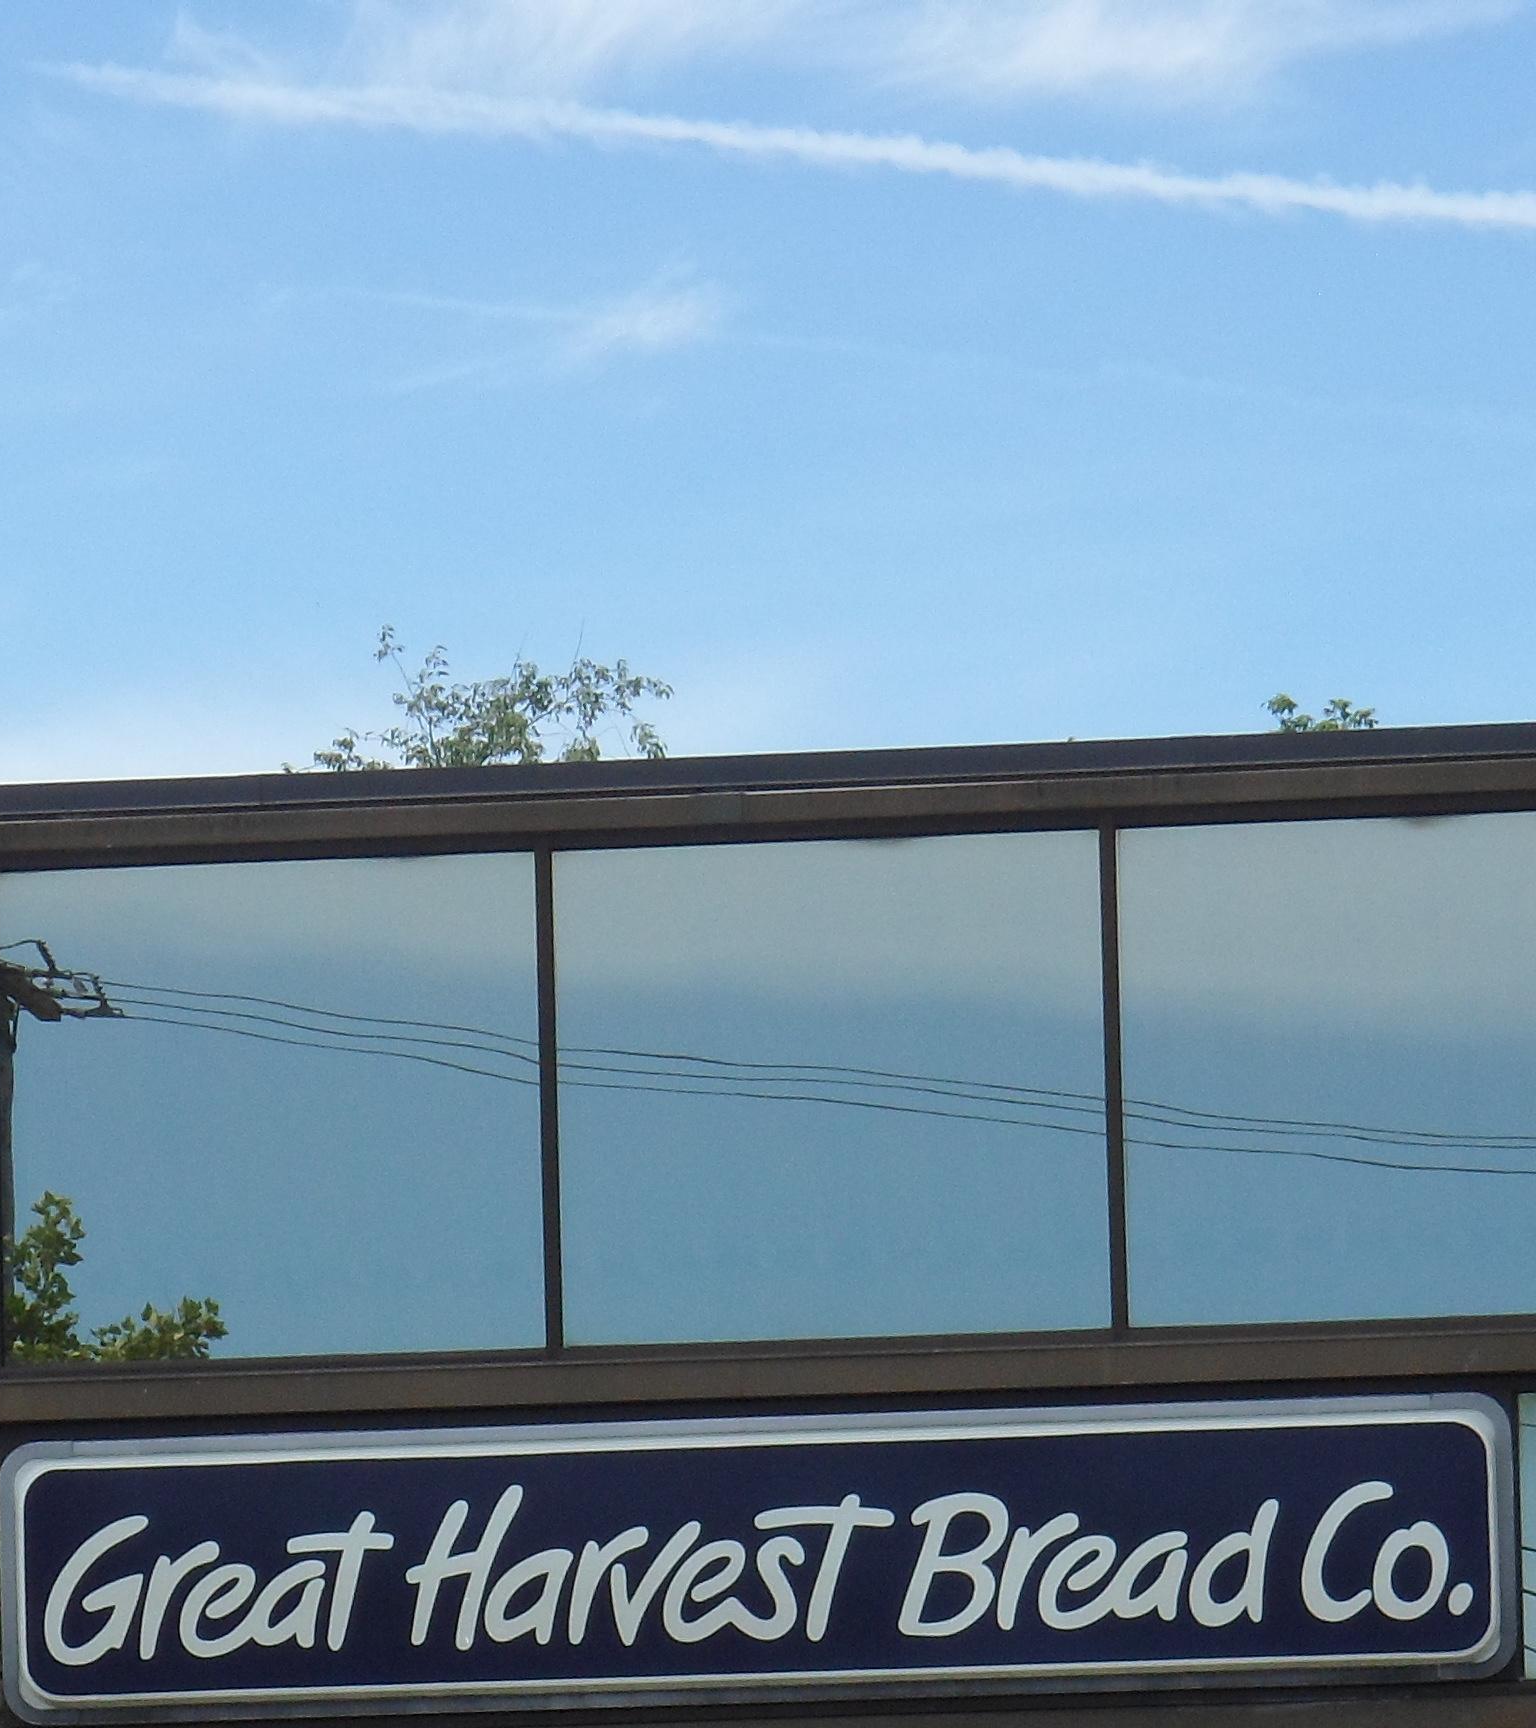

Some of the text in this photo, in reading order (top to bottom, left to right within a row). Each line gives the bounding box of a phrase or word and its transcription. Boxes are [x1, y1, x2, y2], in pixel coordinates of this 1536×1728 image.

[44, 1480, 1474, 1666] Great Harvest Bread Co.
